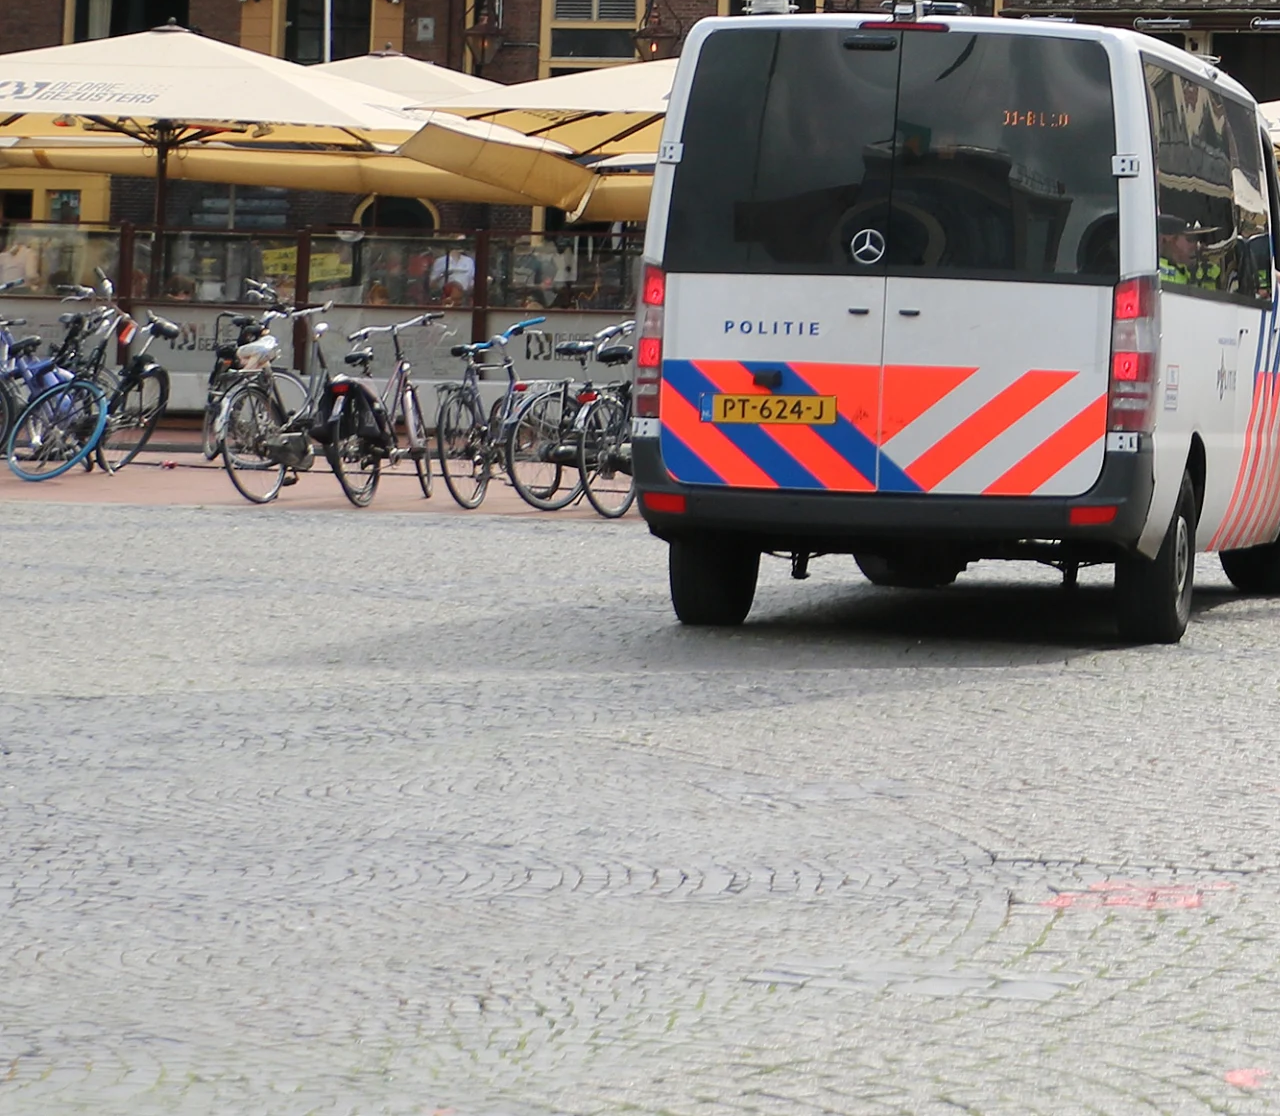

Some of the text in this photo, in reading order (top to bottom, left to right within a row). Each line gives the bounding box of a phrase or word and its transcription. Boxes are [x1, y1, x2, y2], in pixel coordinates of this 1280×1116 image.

[36, 91, 160, 104] GEZUSTERS
[724, 320, 820, 336] POLITIE
[723, 398, 824, 420] PT-624-J
